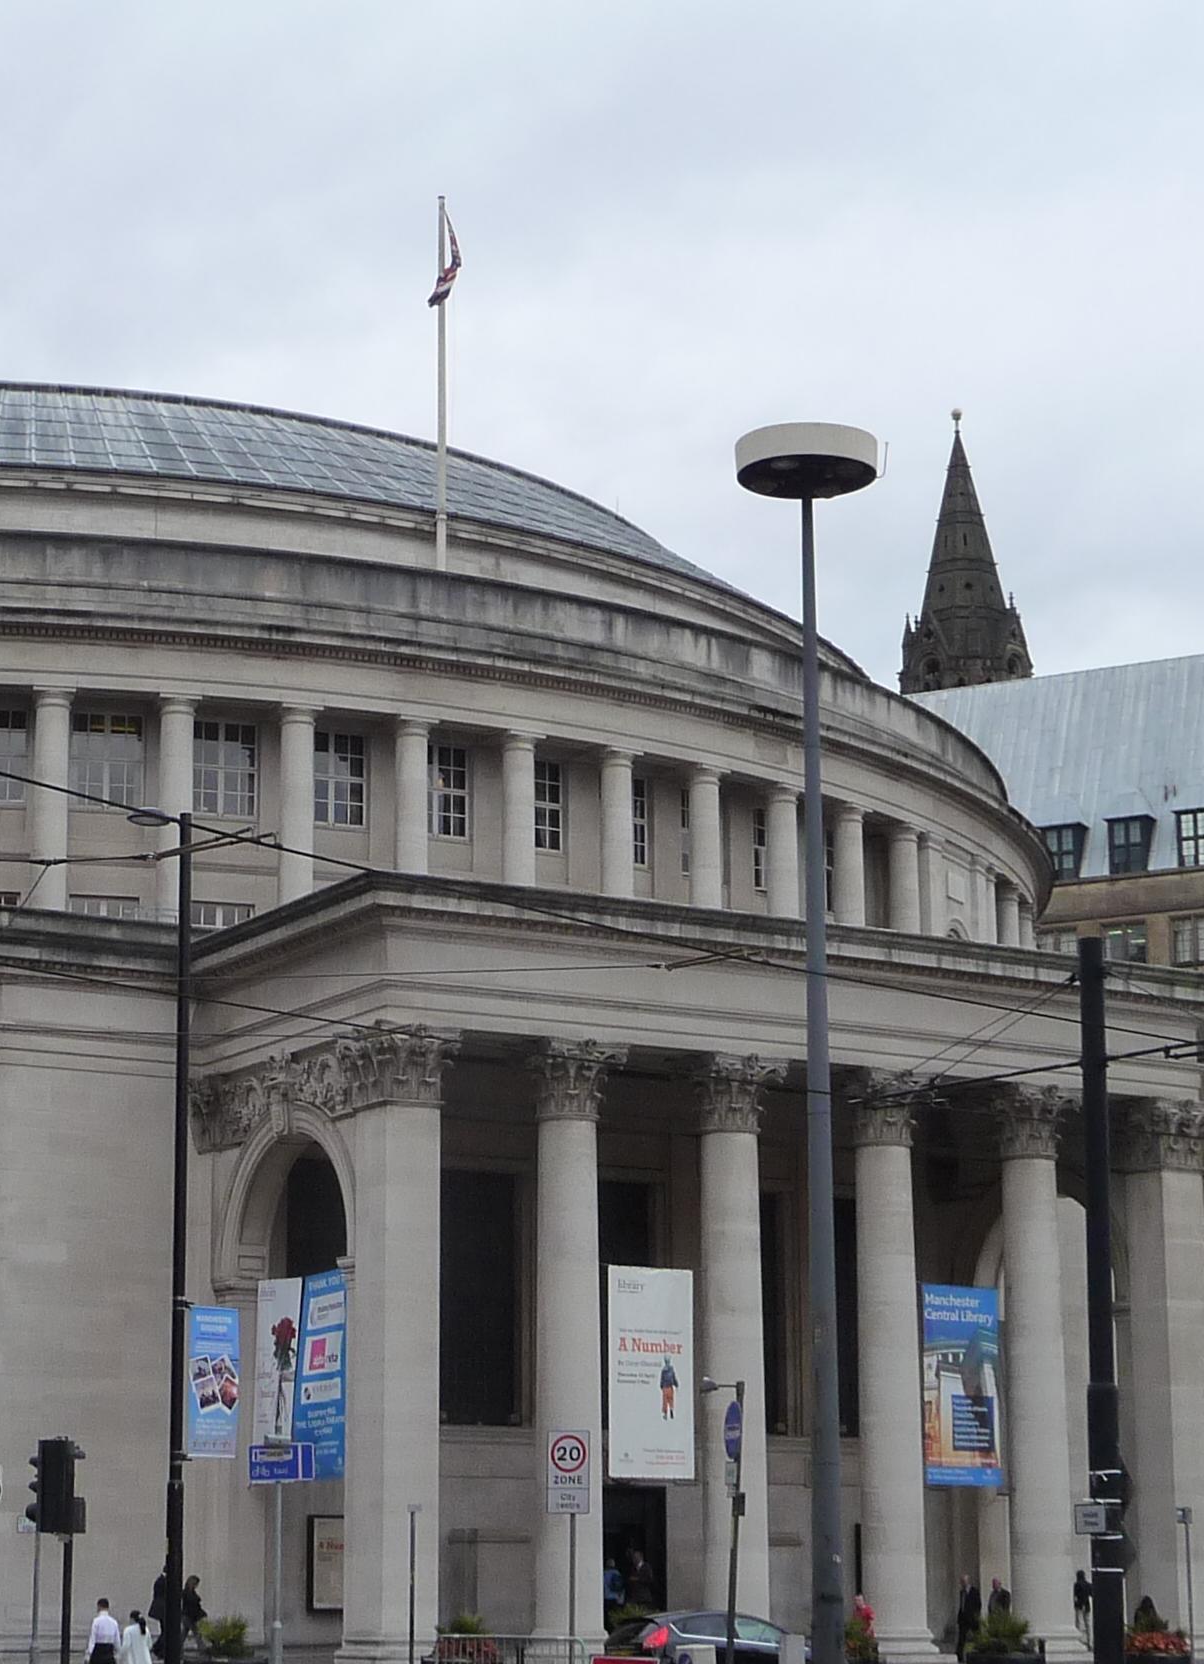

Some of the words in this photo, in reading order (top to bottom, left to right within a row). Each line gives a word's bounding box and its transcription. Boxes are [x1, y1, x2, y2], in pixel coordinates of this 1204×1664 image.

[924, 1292, 980, 1308] Manchester
[924, 1308, 959, 1321] Central
[961, 1310, 994, 1327] Library
[618, 1337, 628, 1352] A
[631, 1338, 683, 1354] Number
[556, 1446, 581, 1461] 20
[553, 1475, 583, 1485] ZONE
